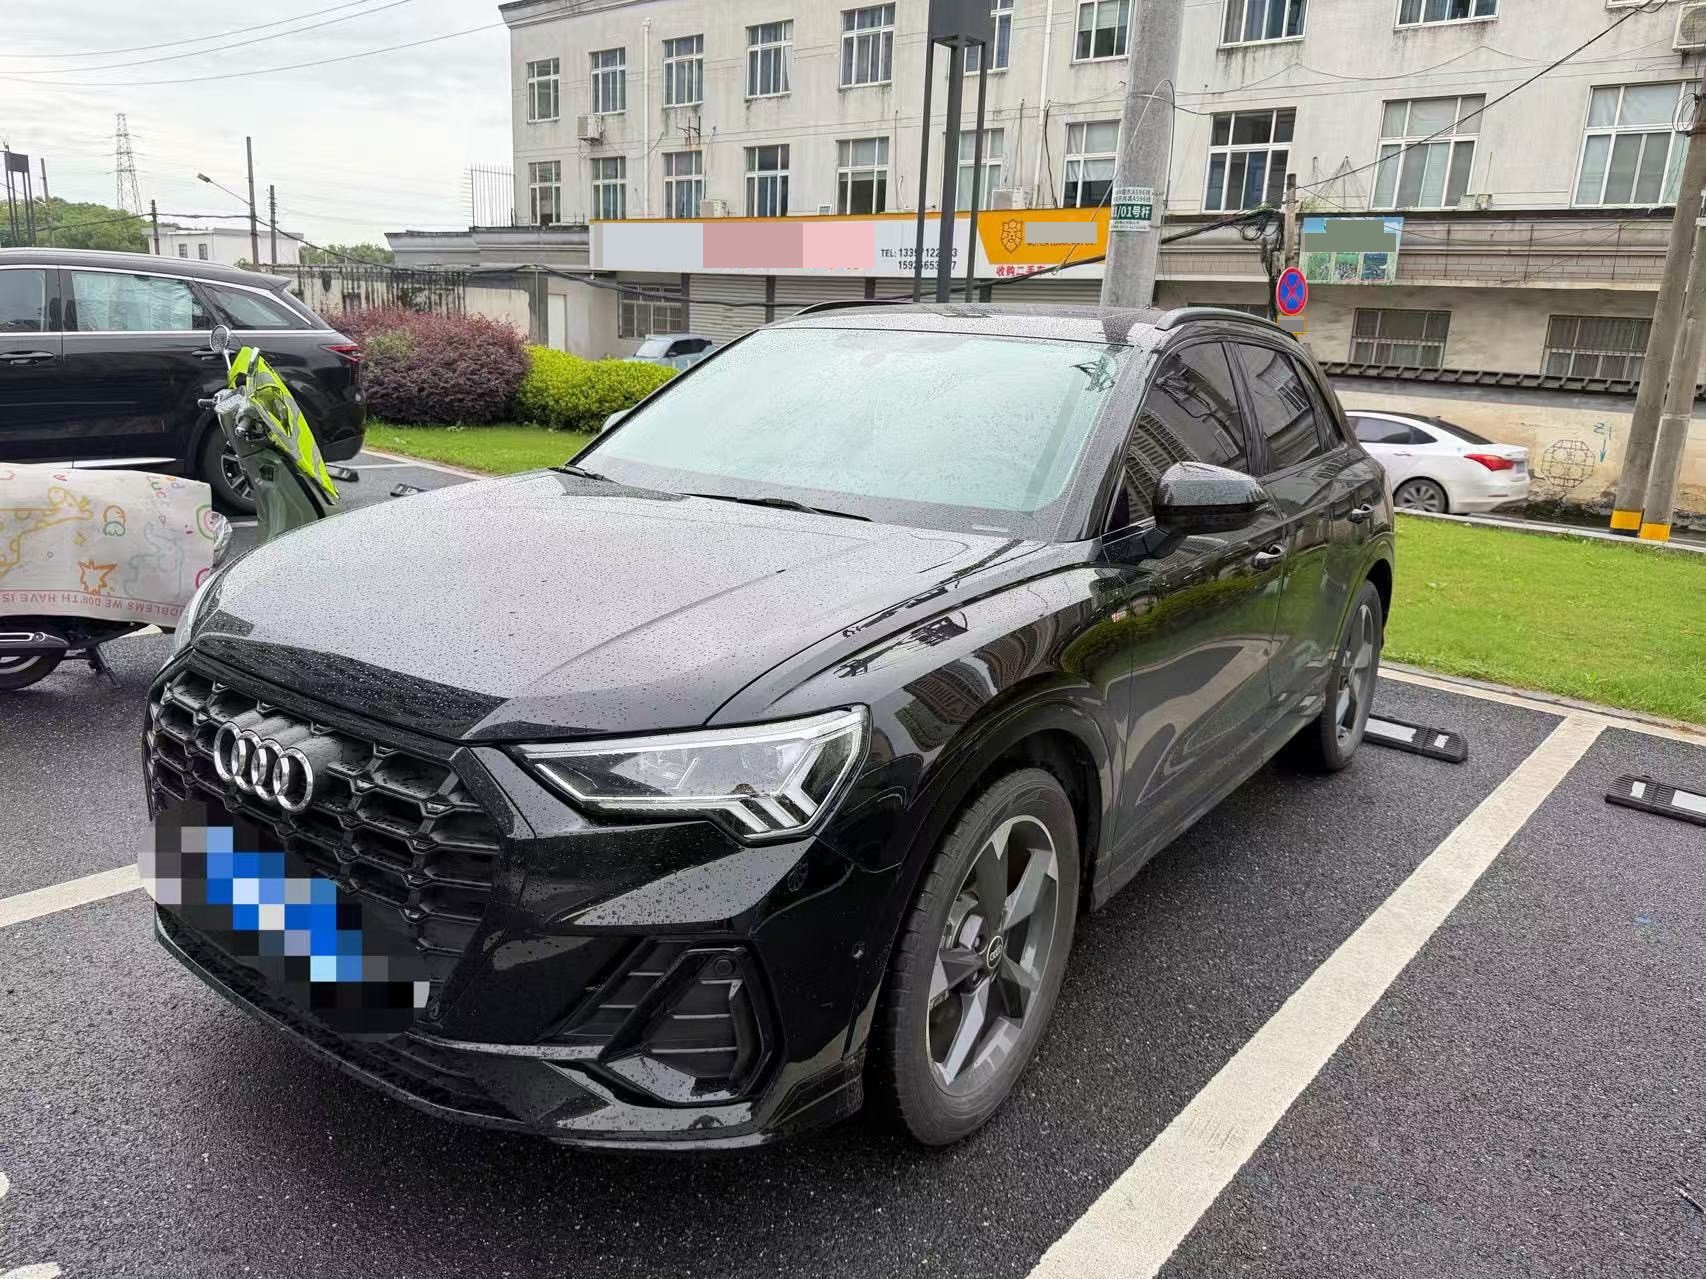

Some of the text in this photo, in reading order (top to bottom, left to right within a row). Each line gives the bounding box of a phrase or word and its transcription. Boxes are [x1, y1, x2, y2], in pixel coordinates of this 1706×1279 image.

[880, 248, 897, 258] TEL:
[20, 593, 56, 602] HAVE
[105, 599, 122, 609] WE
[127, 601, 183, 617] OBLEMS
